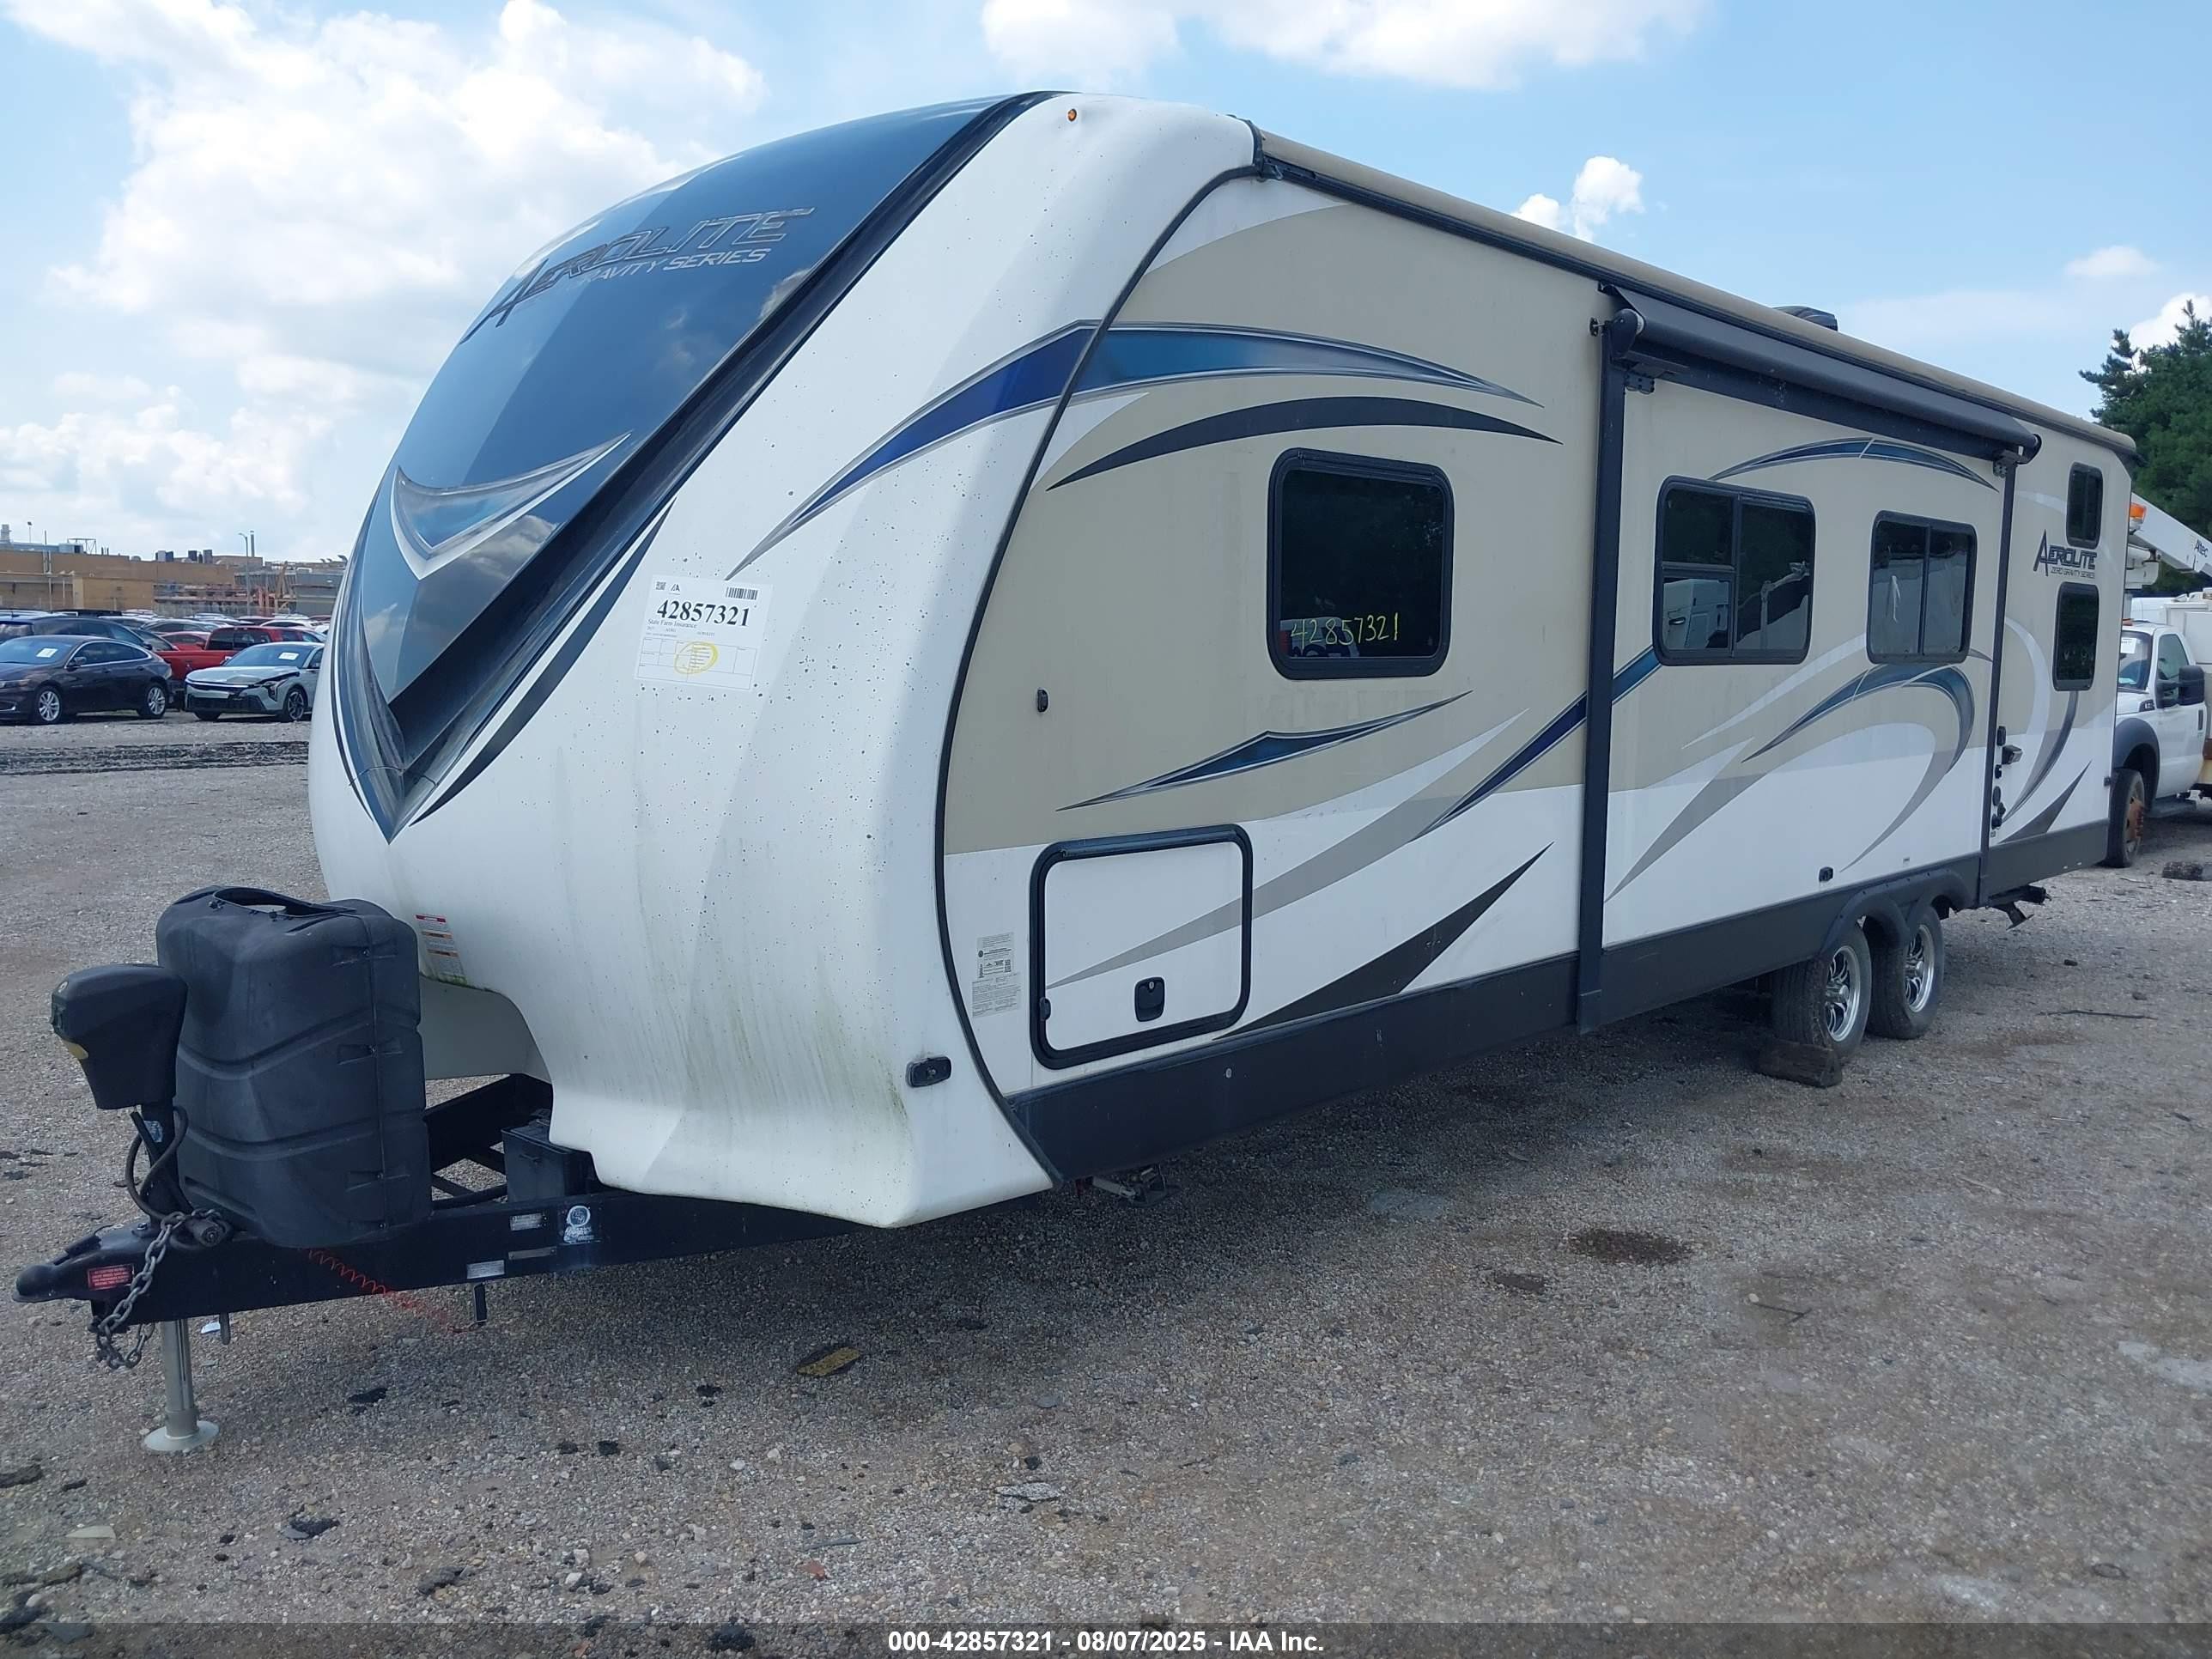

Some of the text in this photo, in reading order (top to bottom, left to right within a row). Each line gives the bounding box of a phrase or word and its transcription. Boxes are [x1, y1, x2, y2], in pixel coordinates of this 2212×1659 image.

[459, 208, 815, 343] AEROLITE
[663, 248, 771, 270] SERIES
[2033, 529, 2097, 577] AEROLITE
[657, 599, 750, 627] 42857321
[1291, 612, 1399, 651] 42857321
